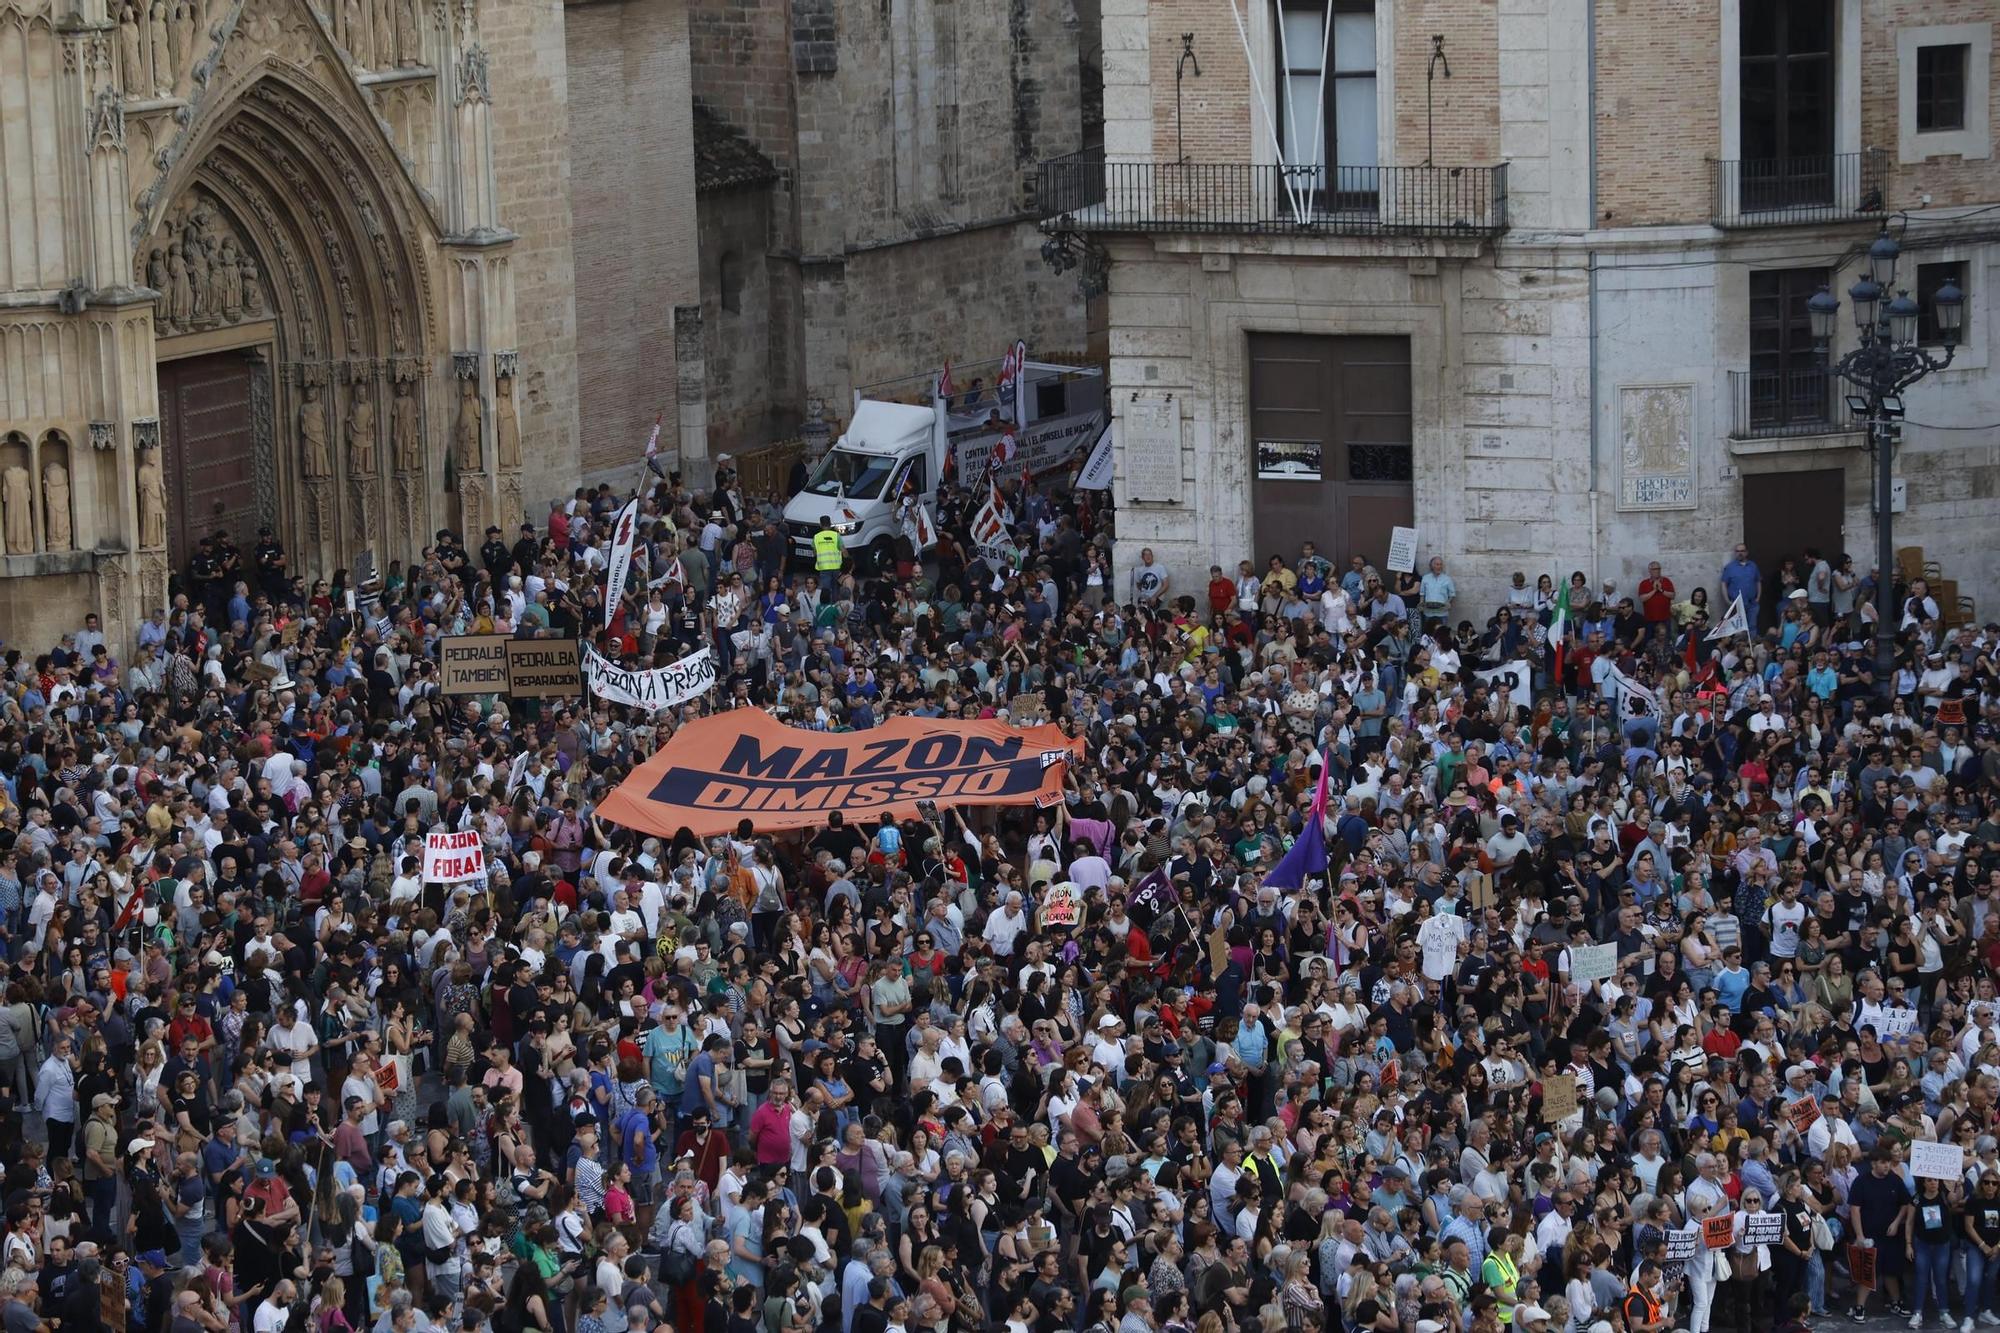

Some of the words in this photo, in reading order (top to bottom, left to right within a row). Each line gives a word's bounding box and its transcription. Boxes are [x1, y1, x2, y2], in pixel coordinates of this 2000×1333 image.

[608, 554, 625, 617] INTERSINDICAL
[513, 670, 580, 688] REPARACIÓN
[645, 675, 656, 700] A
[692, 763, 1011, 811] DIMISSIÓ
[433, 850, 482, 878] FORA!
